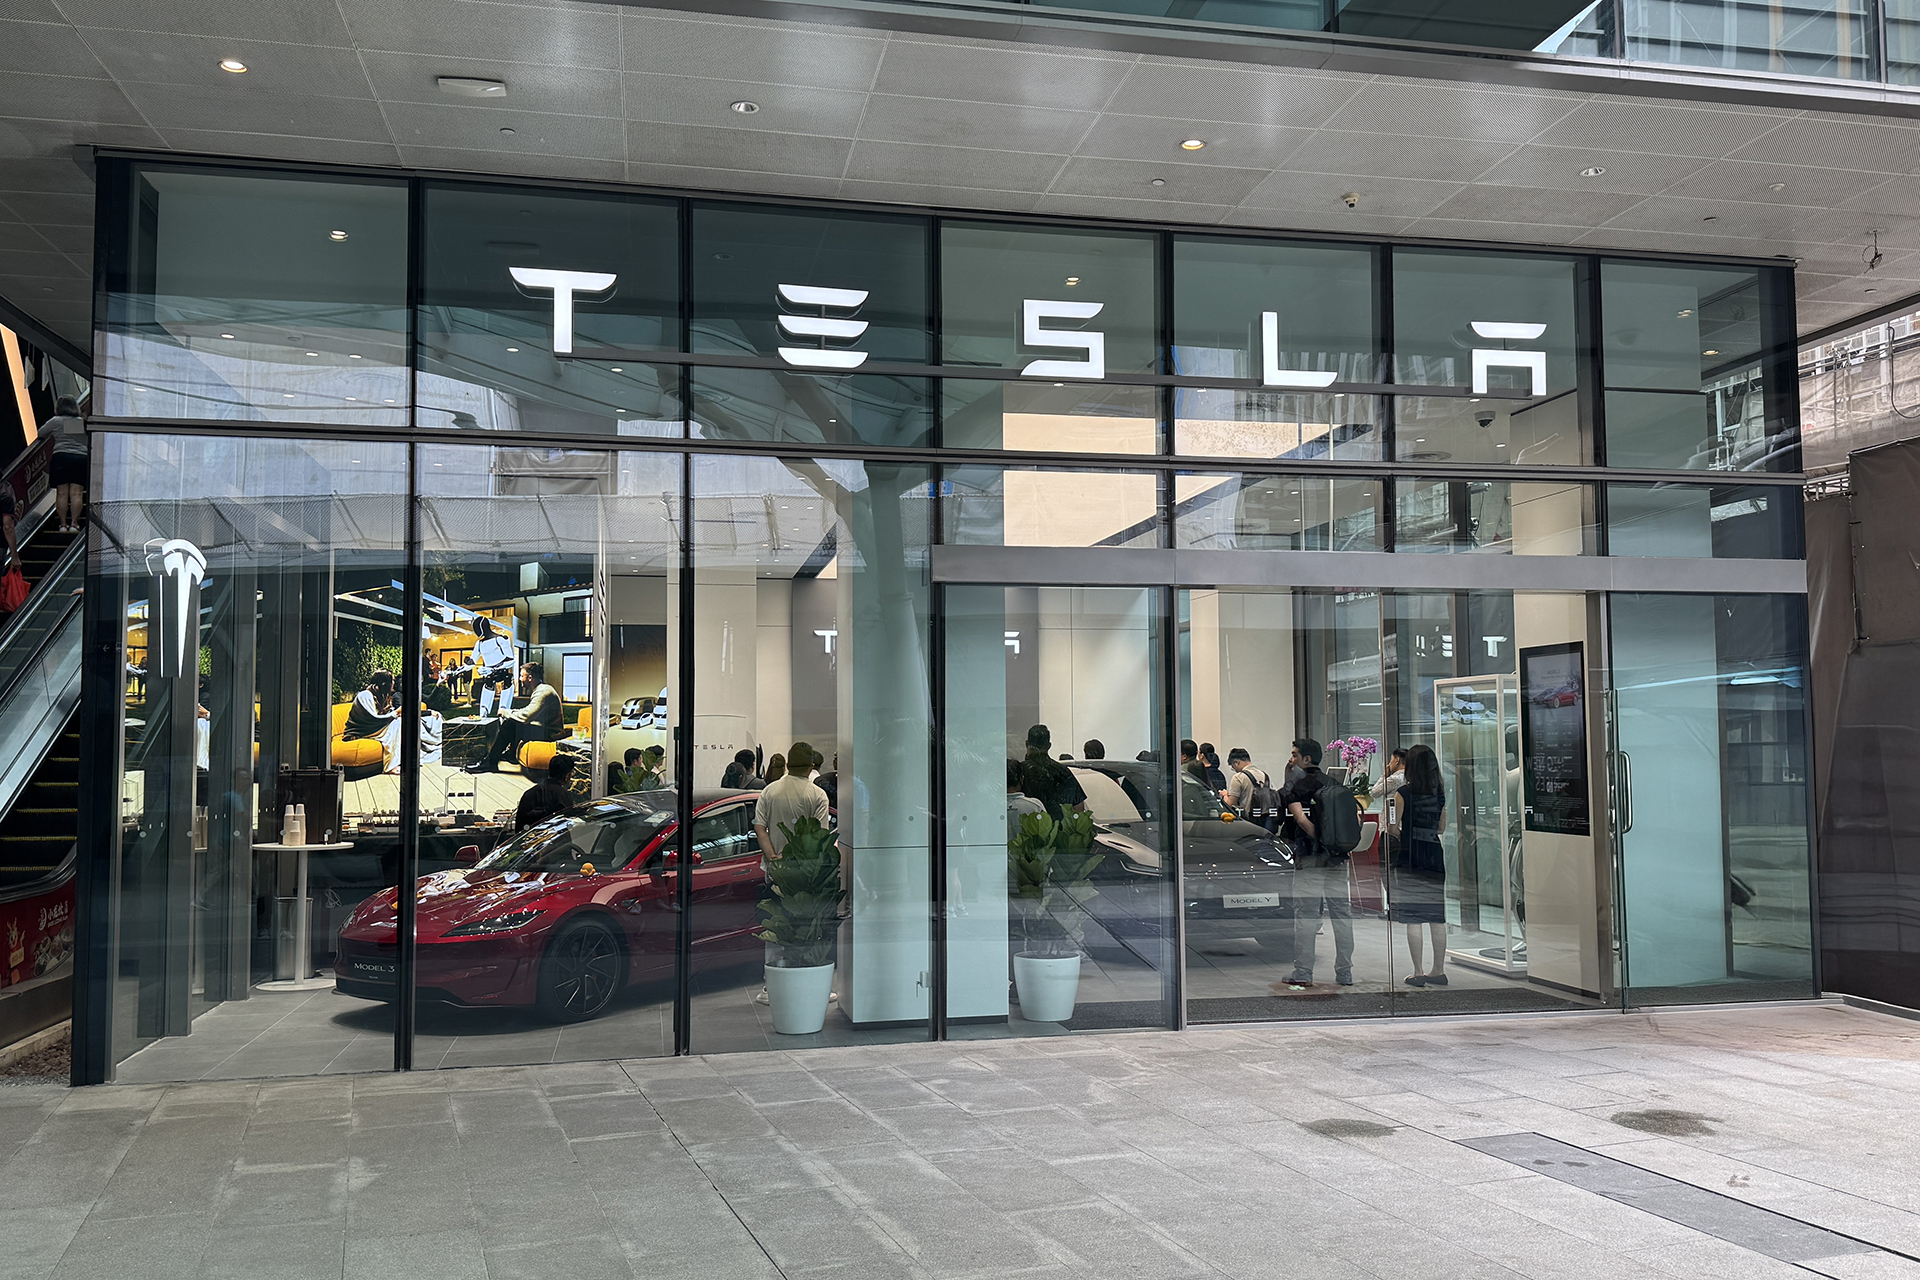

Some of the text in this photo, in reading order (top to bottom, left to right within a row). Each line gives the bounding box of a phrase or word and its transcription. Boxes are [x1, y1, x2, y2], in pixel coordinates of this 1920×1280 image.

[511, 267, 1547, 396] TESLA
[1235, 807, 1311, 817] TESLA
[1461, 806, 1534, 815] TESLA
[354, 962, 395, 973] MODEL 3
